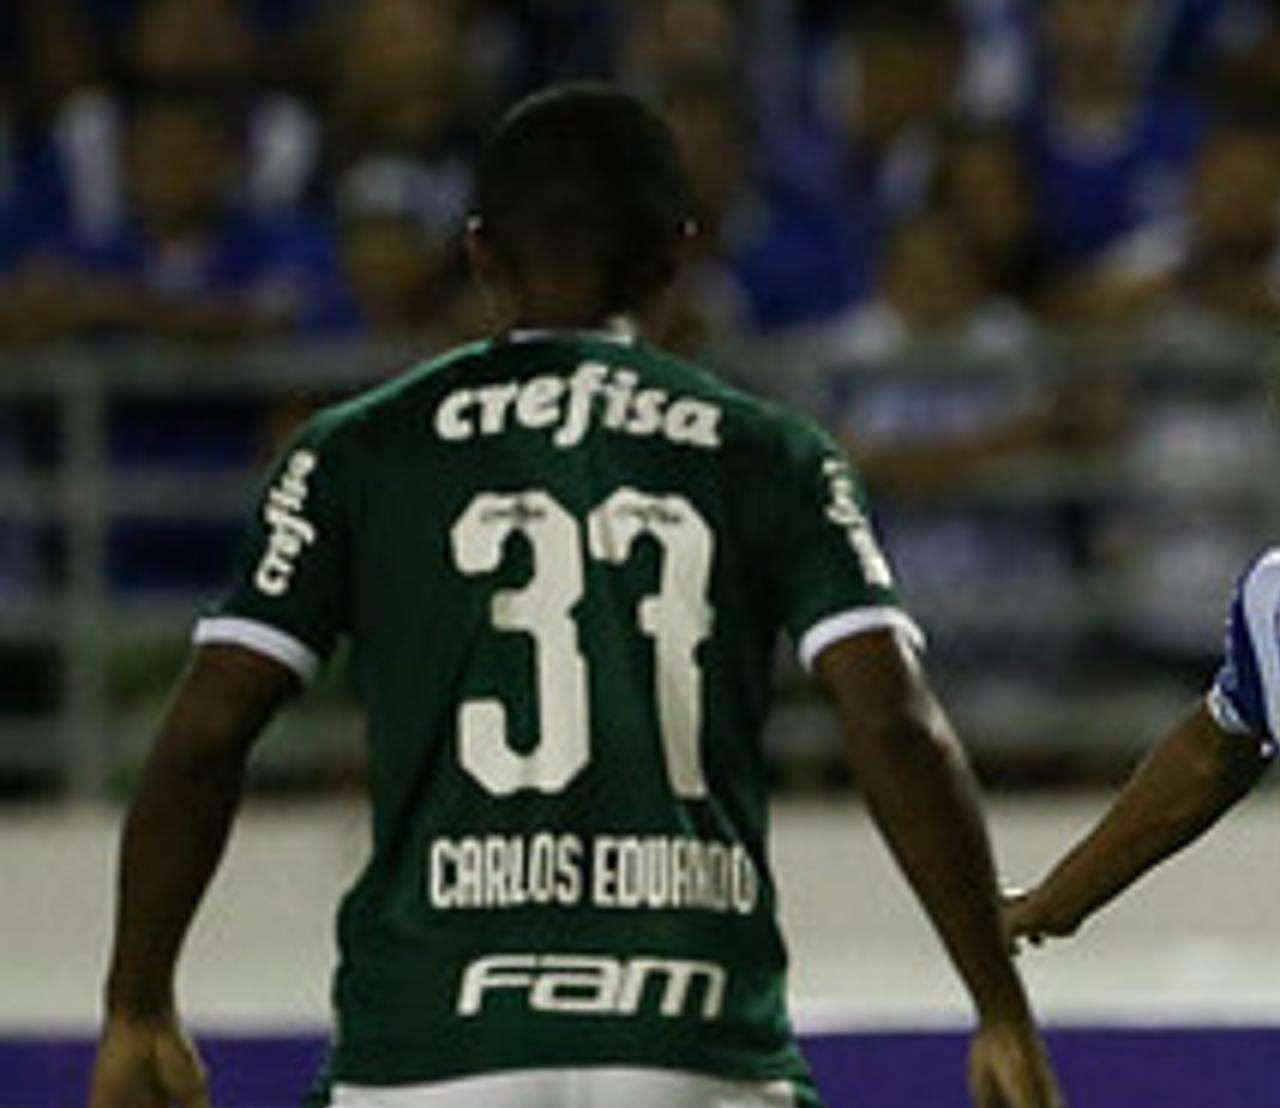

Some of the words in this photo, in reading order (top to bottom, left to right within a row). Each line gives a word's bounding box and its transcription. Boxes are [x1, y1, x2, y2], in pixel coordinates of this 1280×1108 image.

[434, 363, 720, 450] crefisa
[450, 486, 715, 799] 37
[431, 834, 584, 909] CARLOS
